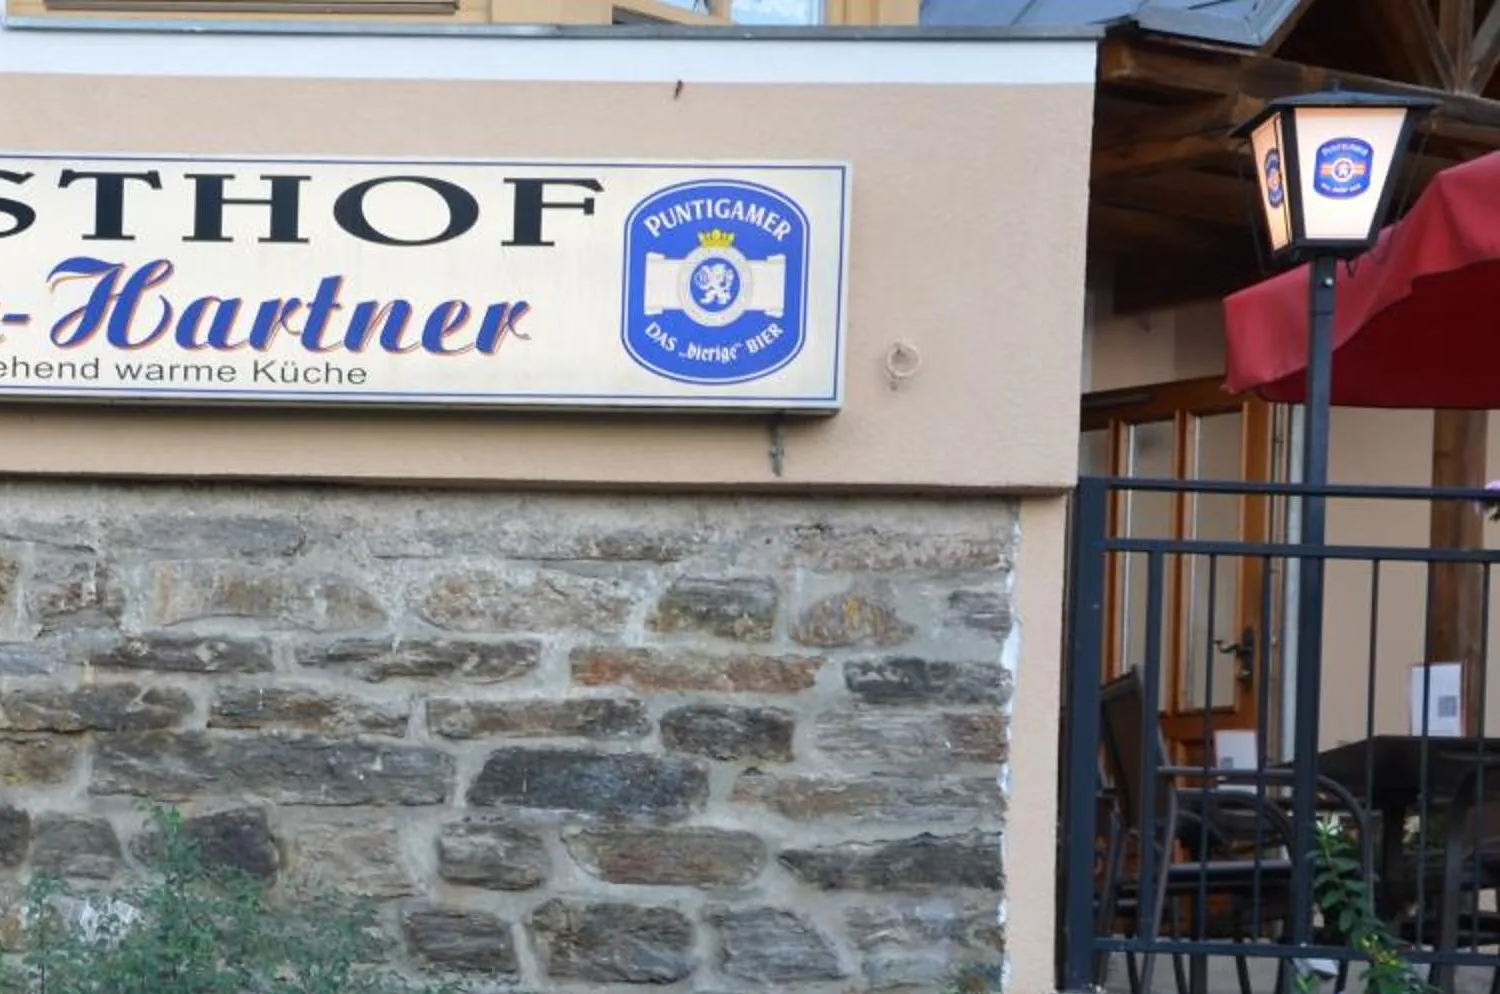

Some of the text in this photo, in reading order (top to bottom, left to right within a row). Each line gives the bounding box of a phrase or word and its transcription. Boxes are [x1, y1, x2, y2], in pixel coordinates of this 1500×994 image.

[643, 198, 792, 242] PUNTIGAMER
[645, 321, 678, 351] DAS
[745, 322, 784, 353] BIER
[114, 363, 238, 382] warme
[252, 360, 368, 386] Küche
